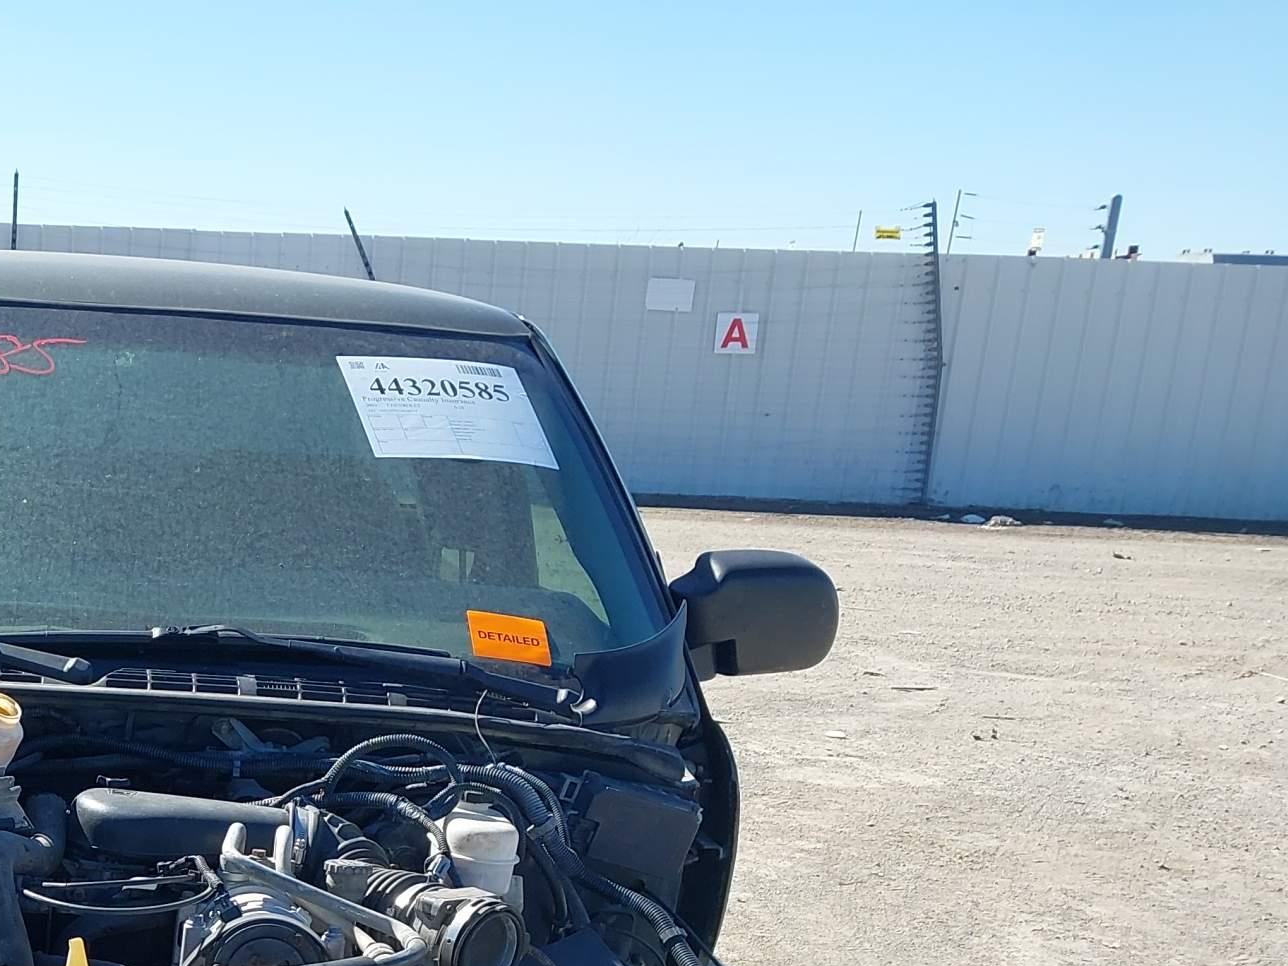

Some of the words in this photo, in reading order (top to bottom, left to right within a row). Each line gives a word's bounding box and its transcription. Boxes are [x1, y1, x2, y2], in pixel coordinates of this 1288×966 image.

[720, 318, 749, 349] A
[369, 377, 510, 402] 44320585
[477, 630, 540, 647] DETAILED
